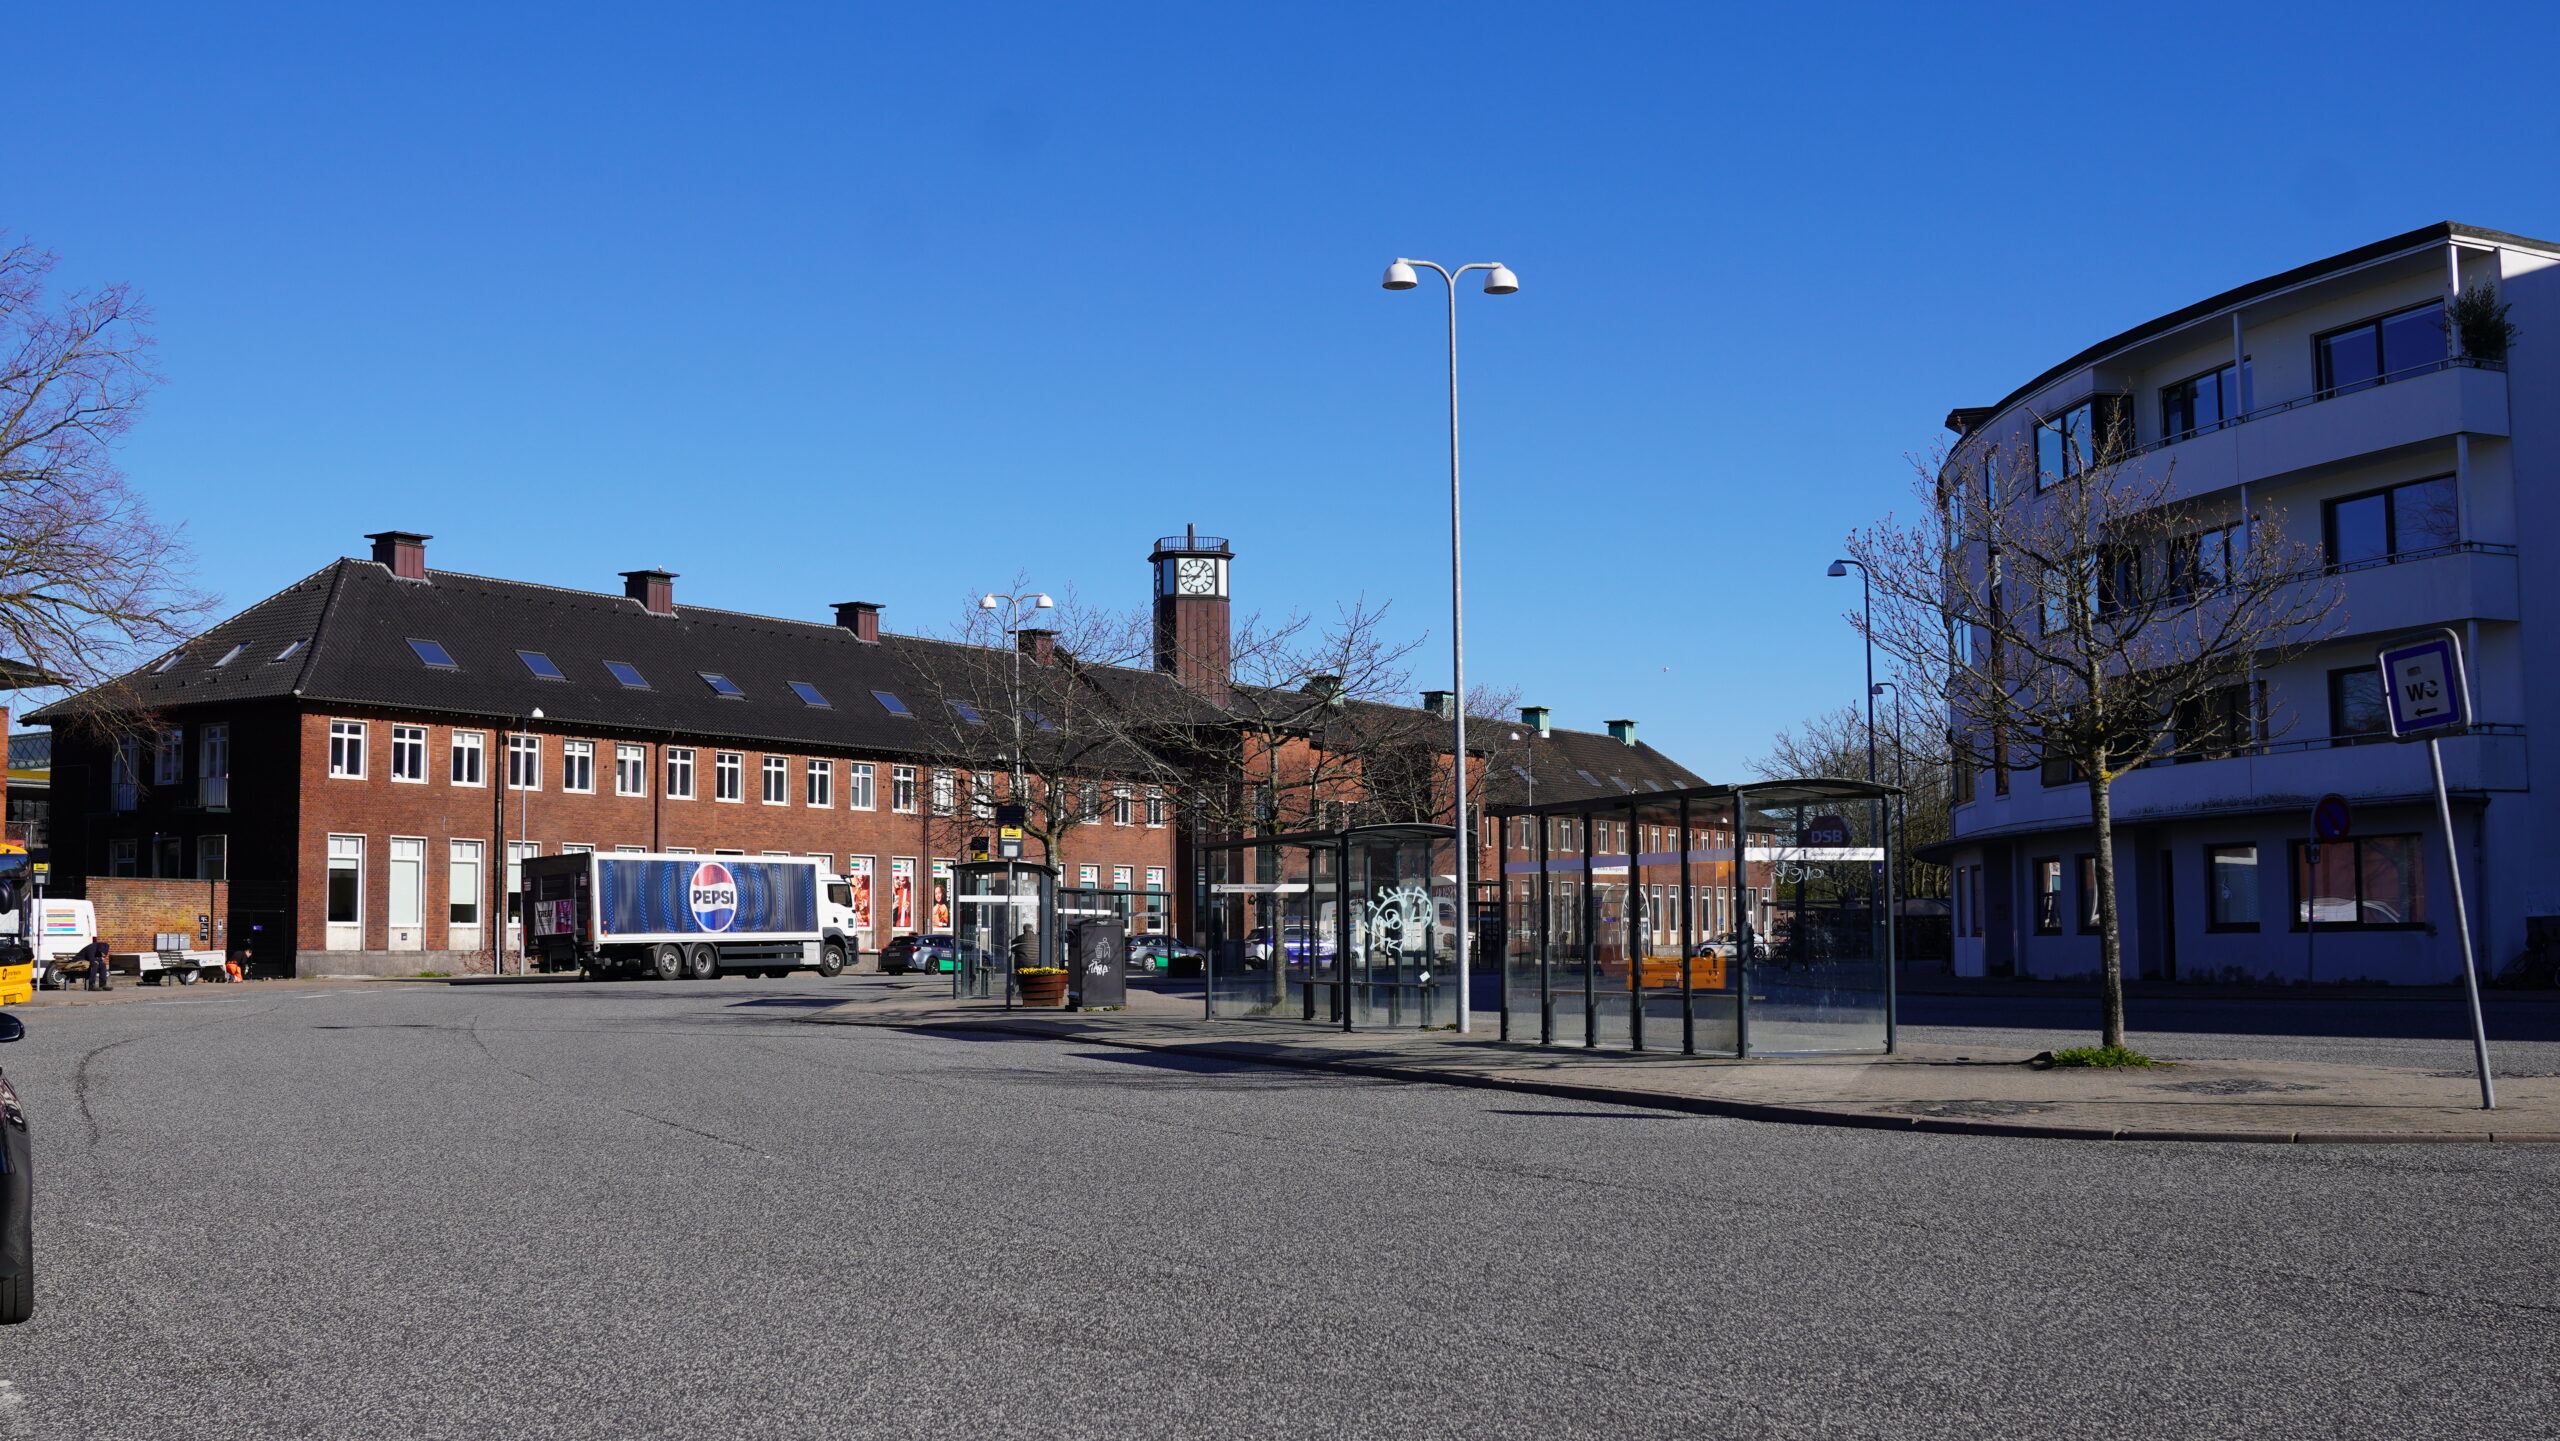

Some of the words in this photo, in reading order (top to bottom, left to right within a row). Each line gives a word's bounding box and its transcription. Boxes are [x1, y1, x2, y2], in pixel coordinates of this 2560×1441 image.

[2405, 680, 2439, 702] WC
[1811, 829, 1842, 843] DSB
[1216, 884, 1222, 892] 2
[693, 890, 734, 904] PEPSI
